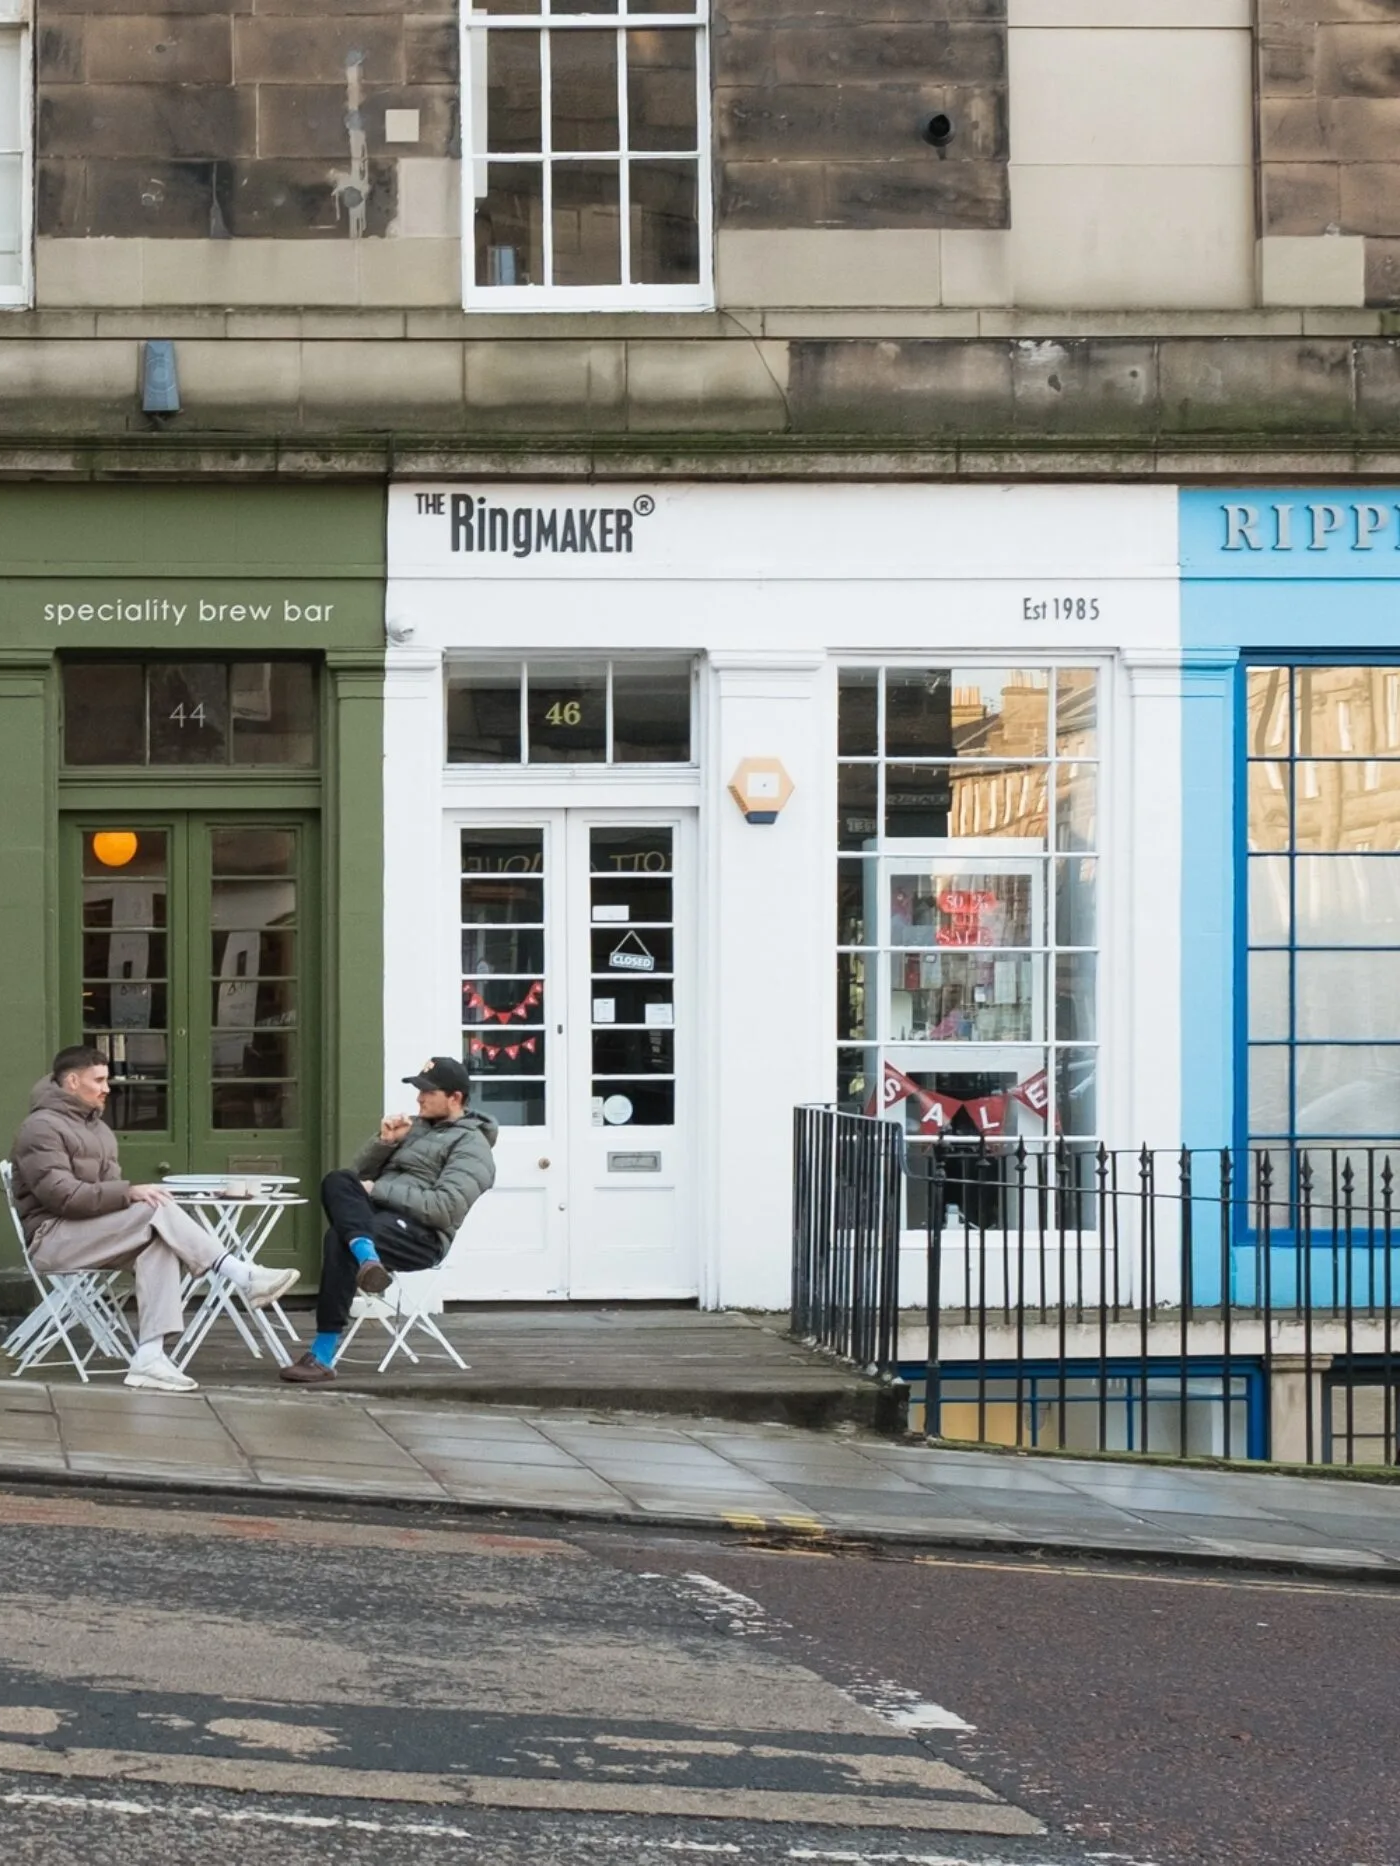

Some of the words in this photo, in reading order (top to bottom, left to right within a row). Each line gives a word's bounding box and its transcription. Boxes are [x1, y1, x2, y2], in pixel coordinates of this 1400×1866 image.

[414, 493, 445, 515] THE
[1220, 504, 1400, 551] RIPP
[43, 599, 187, 626] speciality
[199, 599, 272, 622] brew
[283, 599, 334, 622] bar
[1023, 597, 1047, 620] Est
[1053, 597, 1100, 620] 1985
[169, 702, 206, 728] 44
[544, 701, 582, 726] 46
[613, 955, 651, 968] CLOSED
